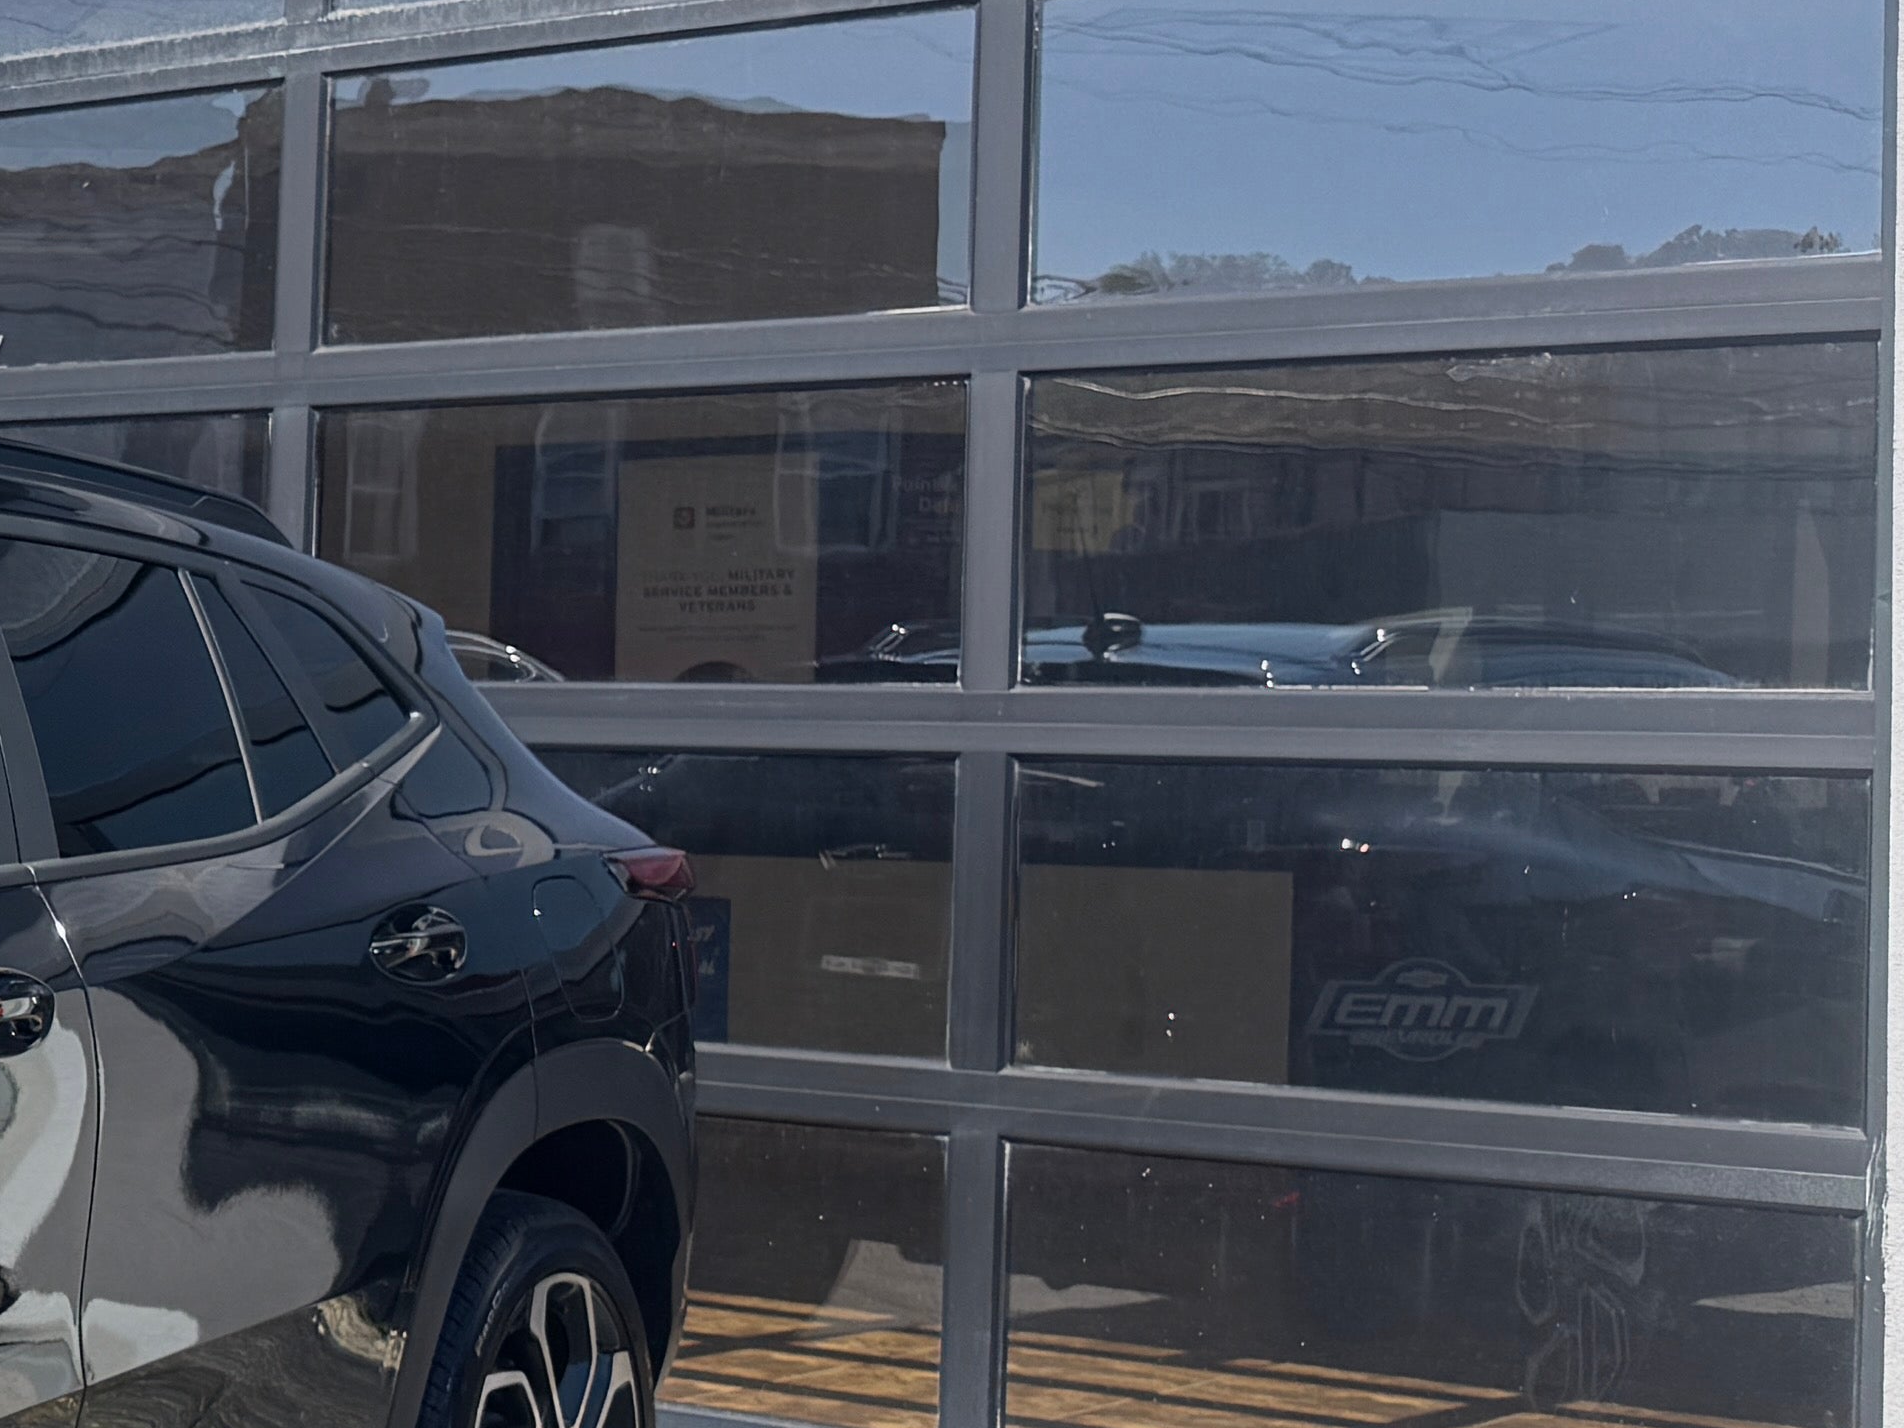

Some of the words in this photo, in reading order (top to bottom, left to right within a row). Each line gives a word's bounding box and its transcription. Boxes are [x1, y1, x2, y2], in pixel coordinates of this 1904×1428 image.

[728, 568, 795, 581] MILITARY
[643, 585, 702, 598] SERVICE
[707, 584, 779, 597] MEMBERS
[678, 600, 757, 613] VETERANS
[1334, 992, 1509, 1029] EMM
